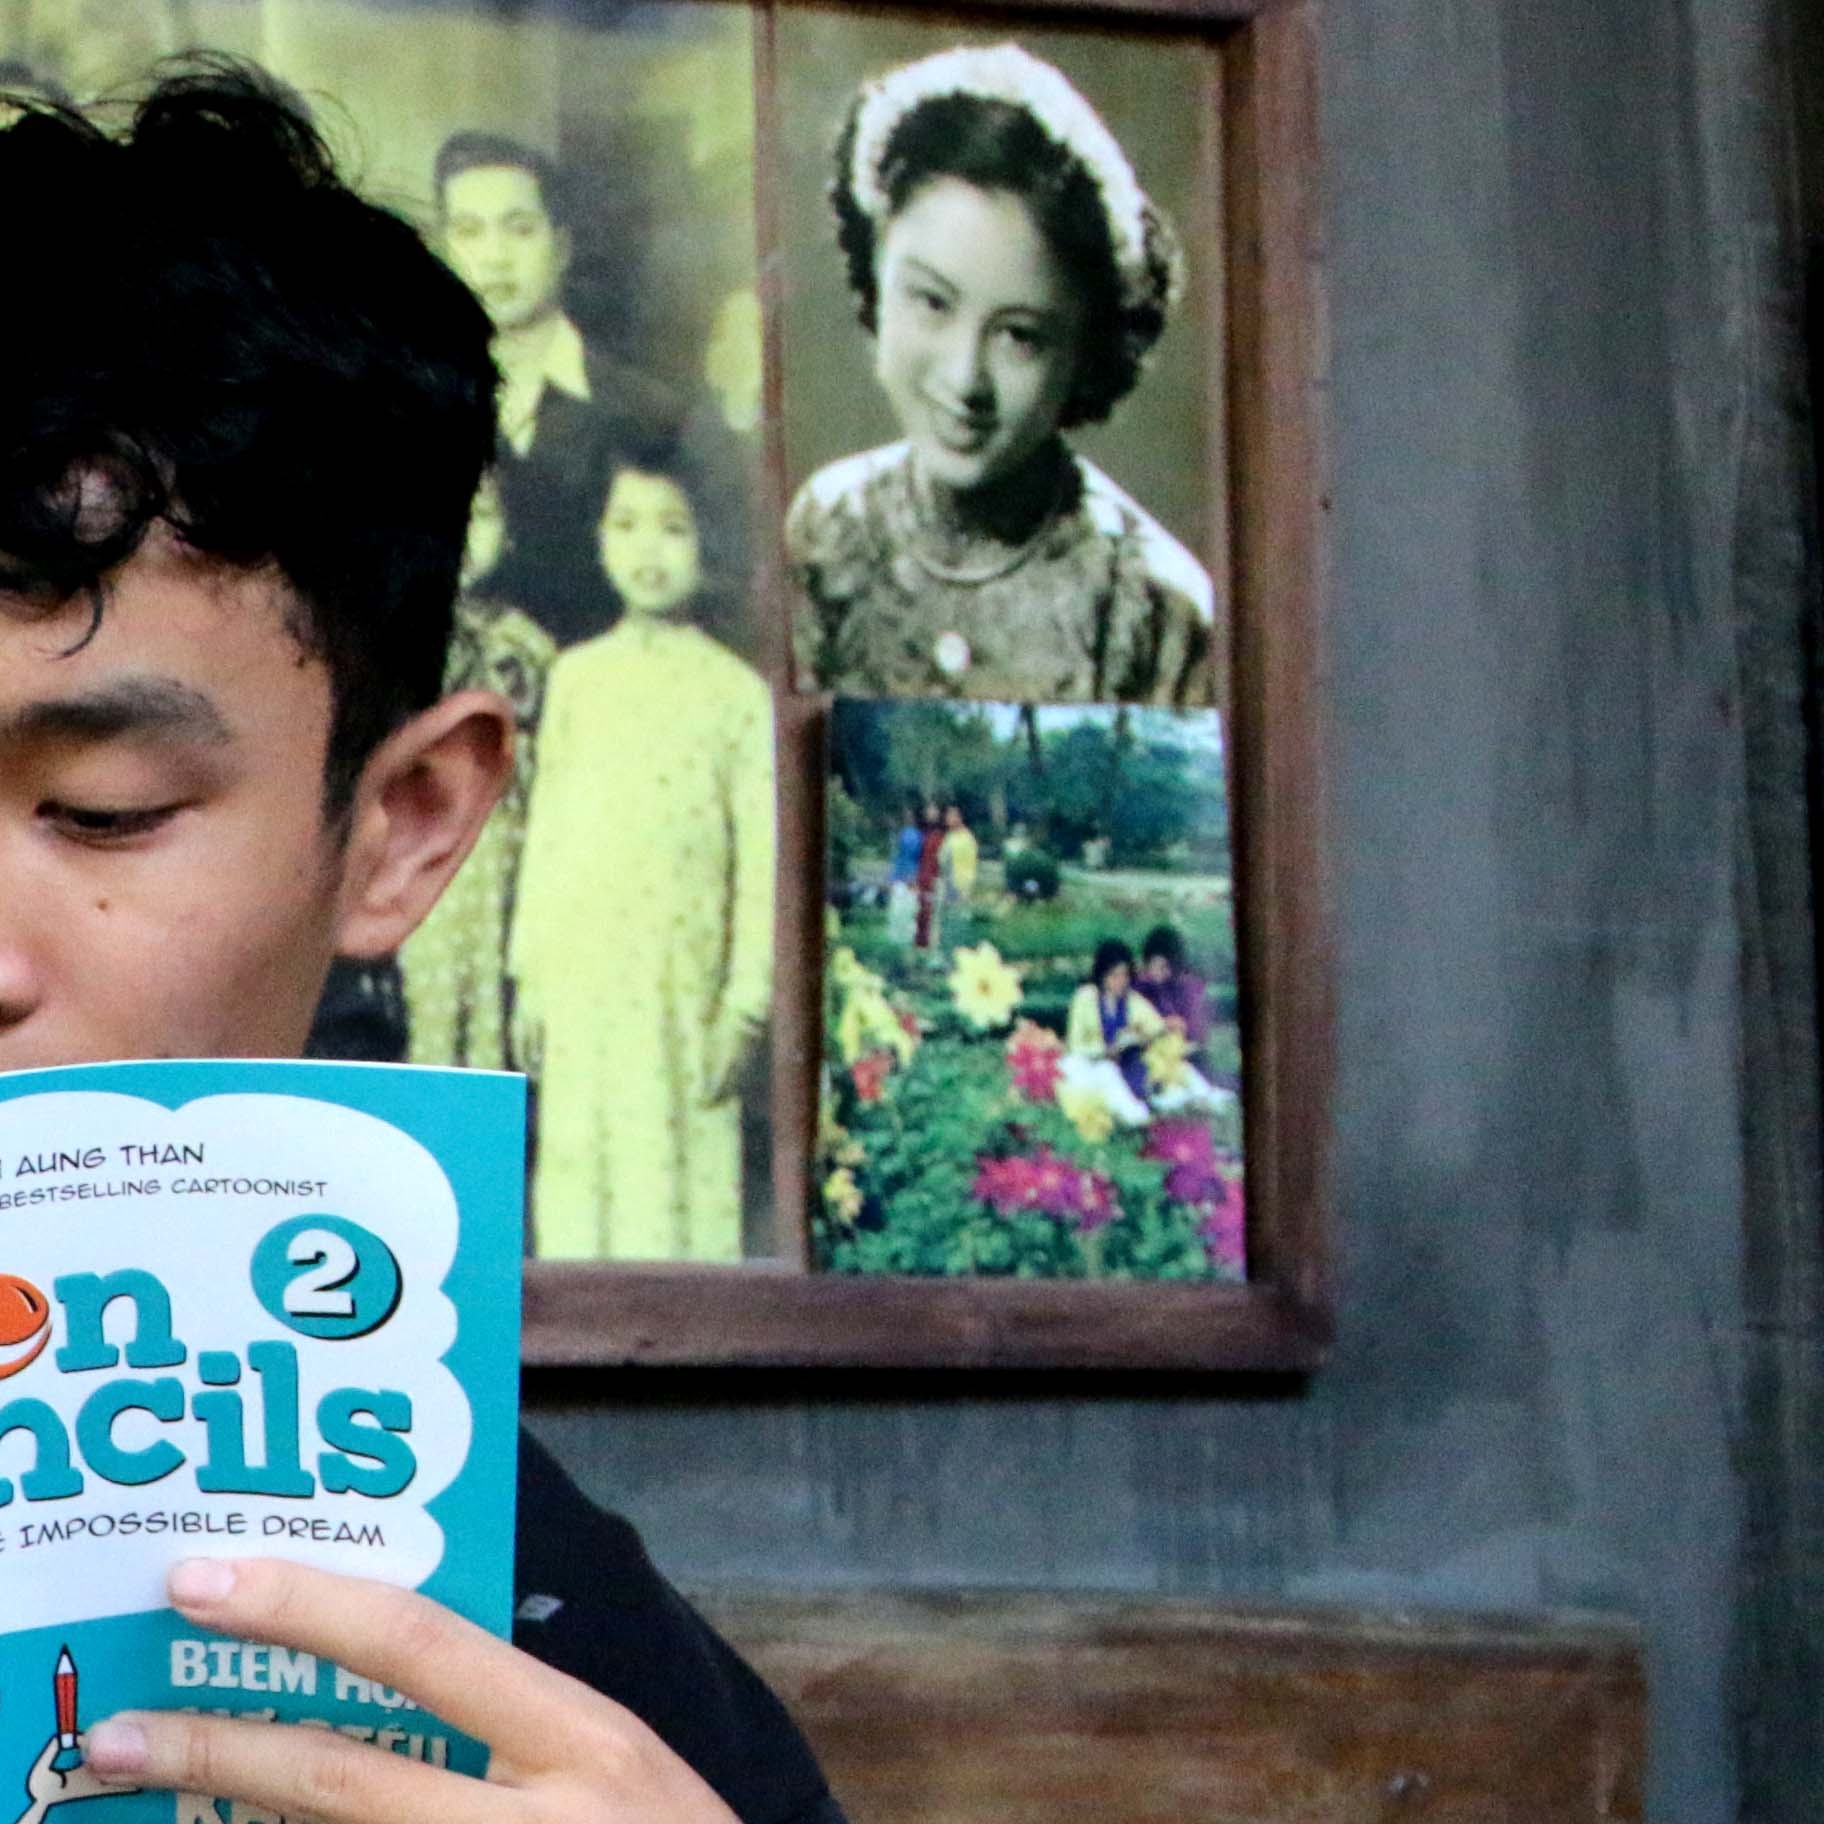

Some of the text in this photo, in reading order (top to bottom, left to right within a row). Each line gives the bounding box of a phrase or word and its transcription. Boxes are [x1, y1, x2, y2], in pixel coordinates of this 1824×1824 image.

[16, 1147, 107, 1179] AUNG
[120, 1142, 205, 1167] THAN
[170, 1177, 328, 1199] CARTOONIST
[282, 1228, 359, 1319] 2
[20, 1511, 246, 1546] IMPOSSIBLE
[262, 1514, 387, 1548] DREAM
